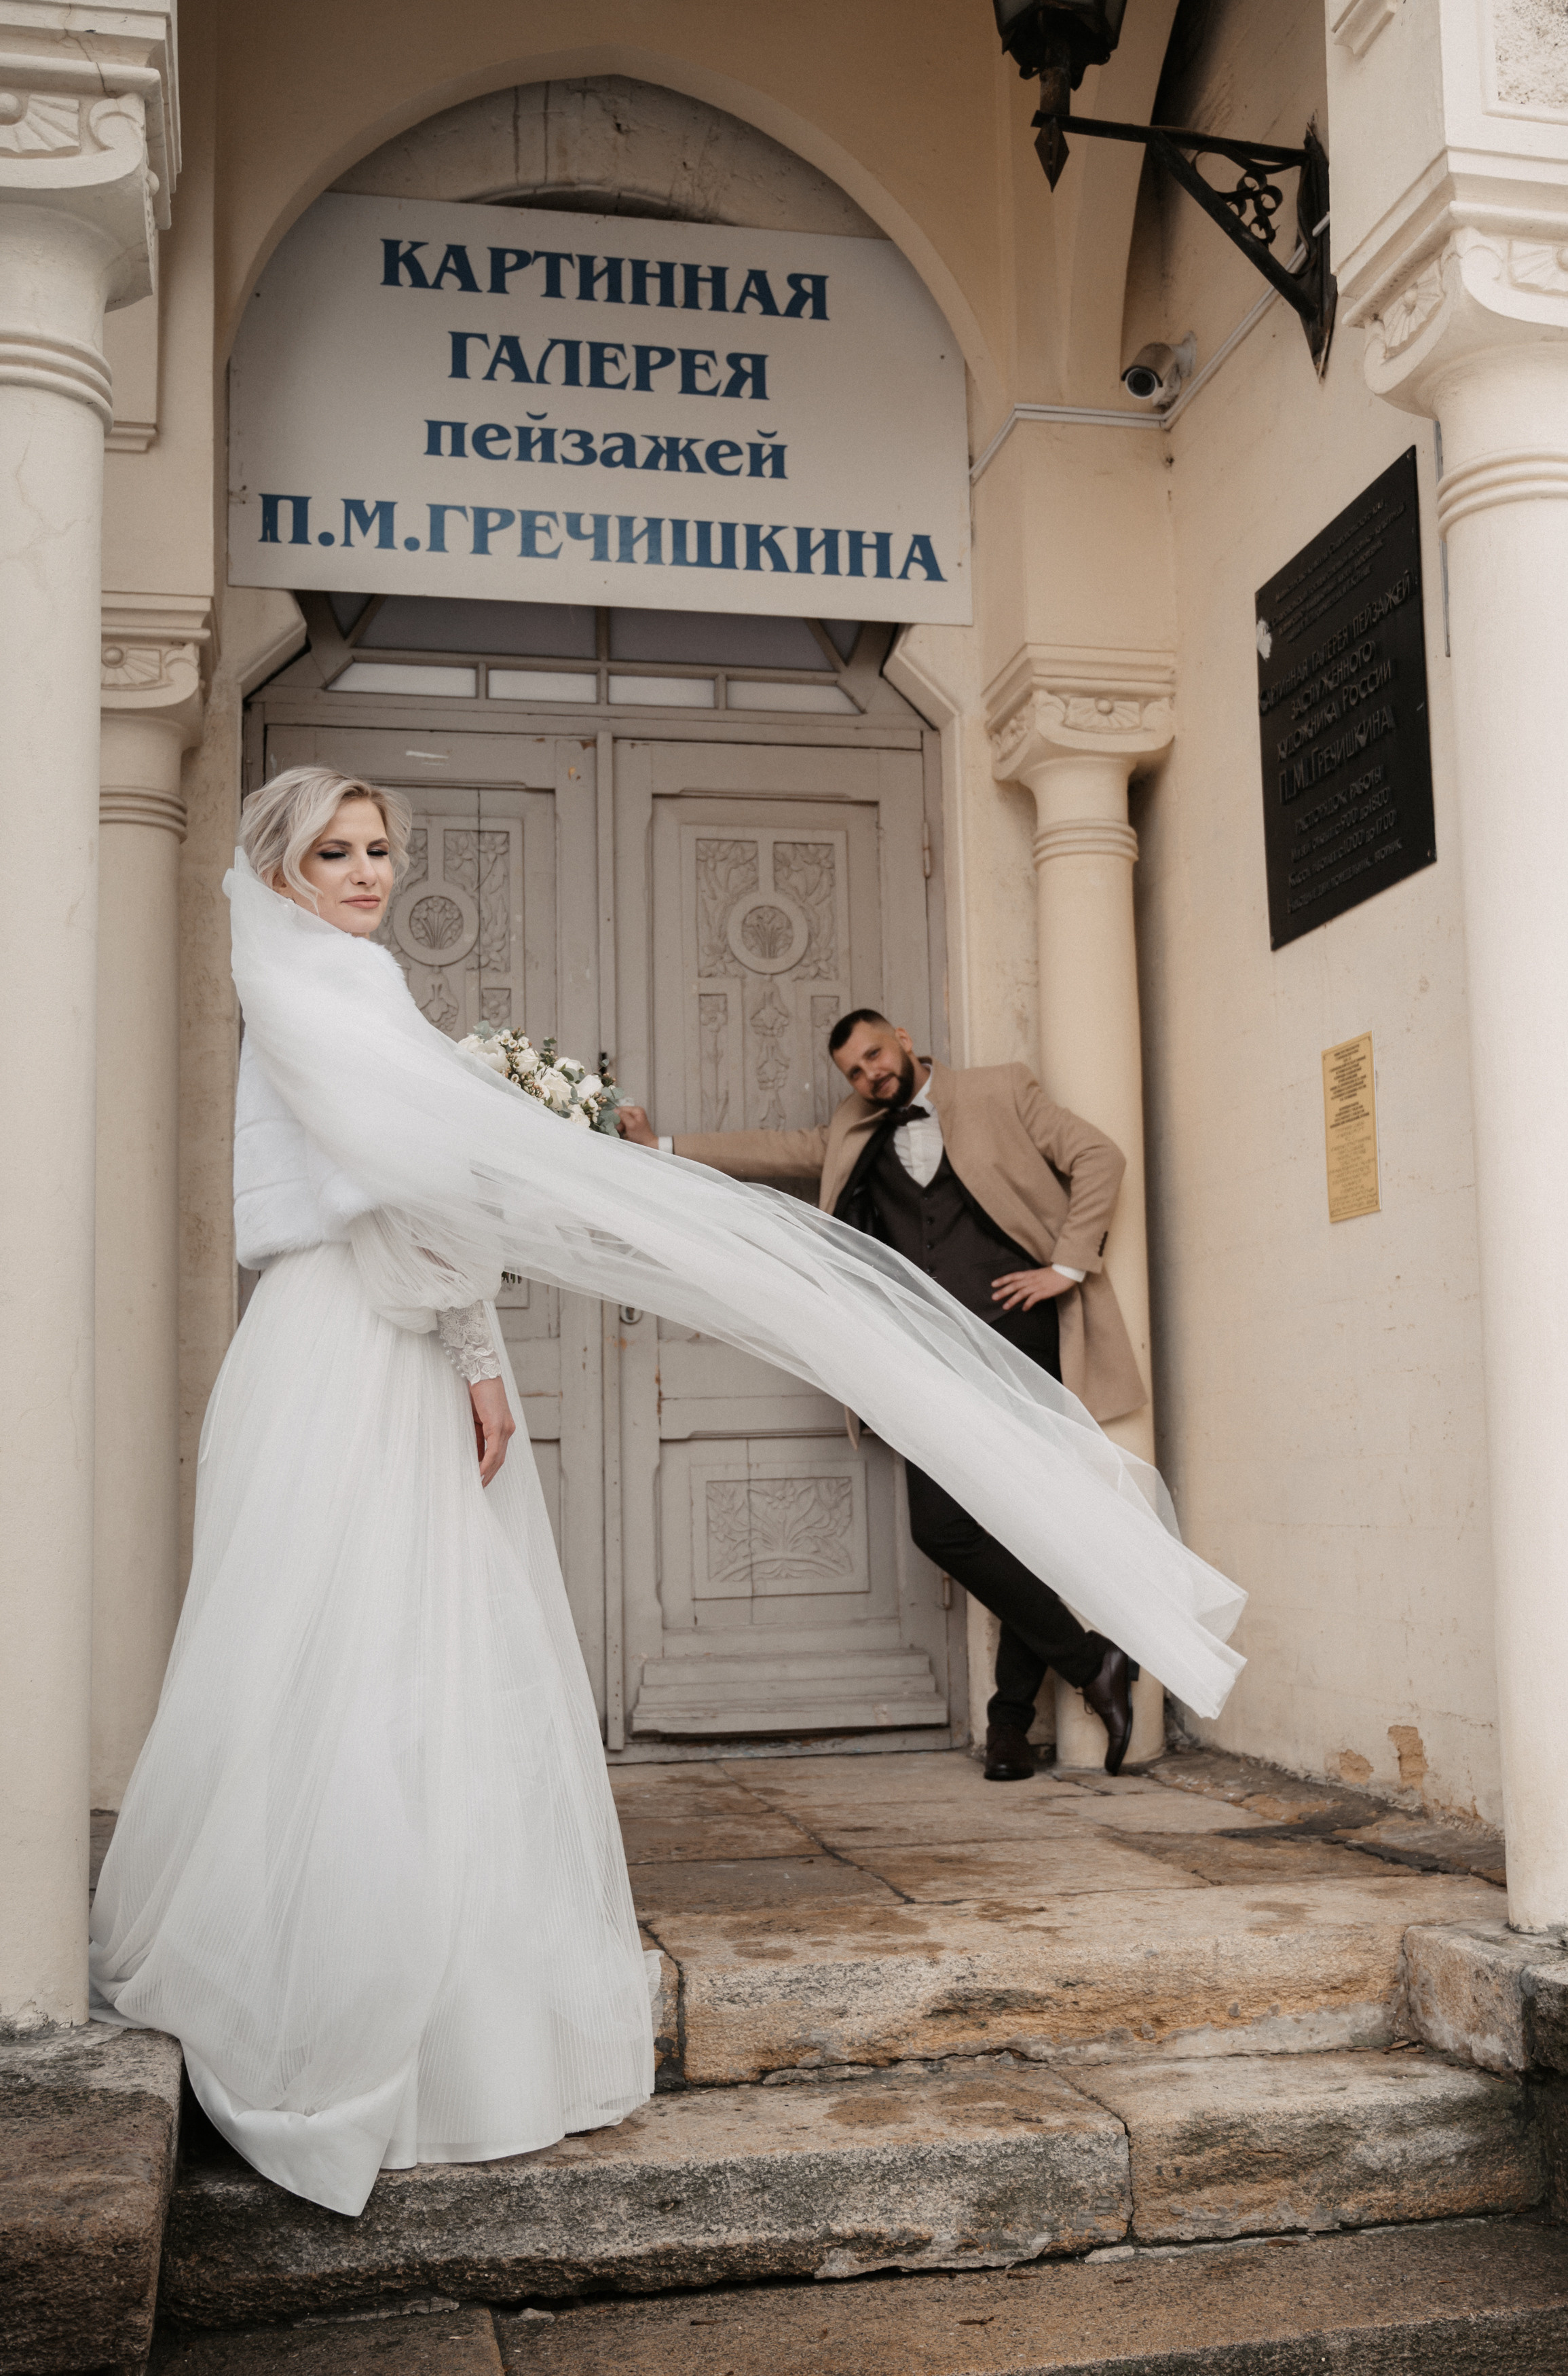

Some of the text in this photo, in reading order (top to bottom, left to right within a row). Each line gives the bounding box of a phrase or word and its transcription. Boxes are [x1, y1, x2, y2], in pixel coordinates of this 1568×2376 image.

[379, 238, 829, 320] КАРТИННАЯ
[448, 331, 769, 400] ГАЛЕРЕЯ
[424, 412, 787, 479] пейзажей
[258, 494, 946, 581] П.М.ГРЕЧИШКИНА
[1311, 623, 1349, 671] ГАЛЕРЕЯ
[1352, 568, 1411, 638] ПЕЙЗАЖЕЙ
[1290, 638, 1373, 720] ЗАСЛУЖЕННОГО
[1276, 699, 1338, 762] ХУДОЖНИКА
